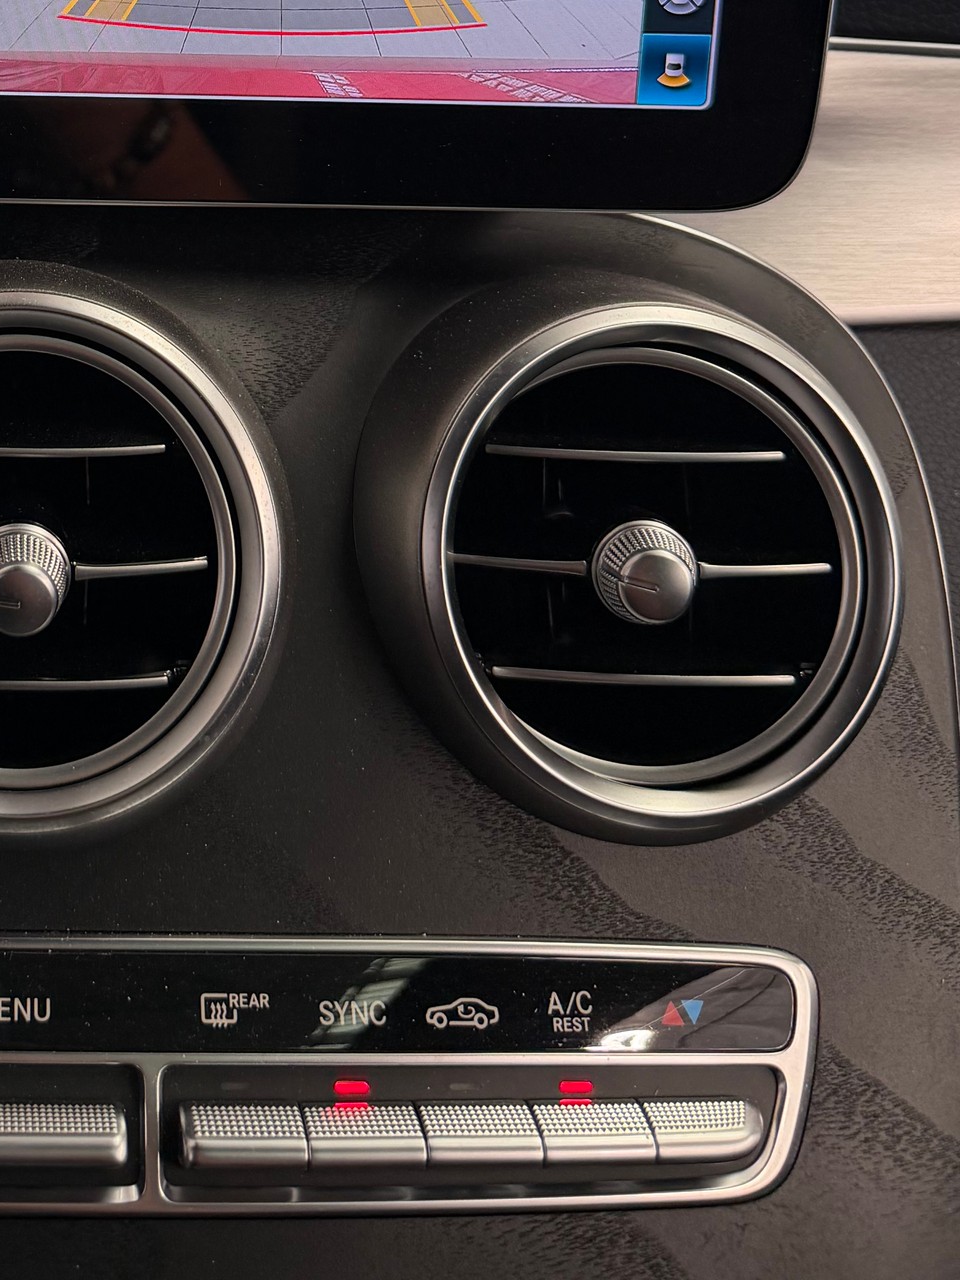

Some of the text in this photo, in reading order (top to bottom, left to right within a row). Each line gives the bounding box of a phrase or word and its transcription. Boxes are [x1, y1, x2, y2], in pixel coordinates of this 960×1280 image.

[228, 992, 270, 1008] REAR
[547, 990, 593, 1016] A/C
[318, 999, 388, 1027] SYNC
[552, 1017, 591, 1033] REST
